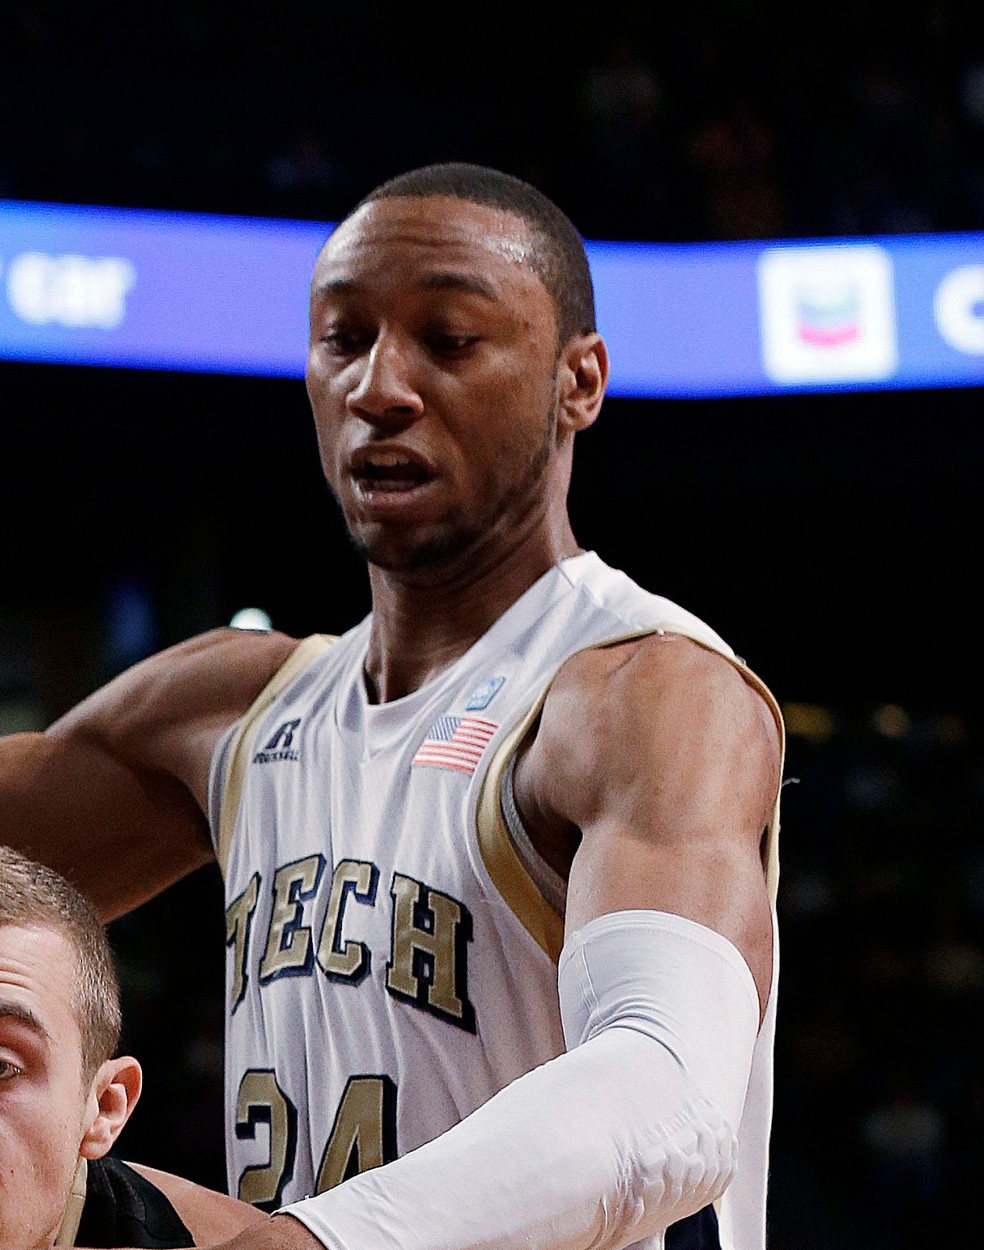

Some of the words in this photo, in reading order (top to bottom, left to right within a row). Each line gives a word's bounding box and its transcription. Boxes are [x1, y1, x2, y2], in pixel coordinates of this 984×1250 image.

[7, 250, 137, 329] car
[226, 853, 480, 1036] TECH
[236, 1068, 400, 1216] 24
